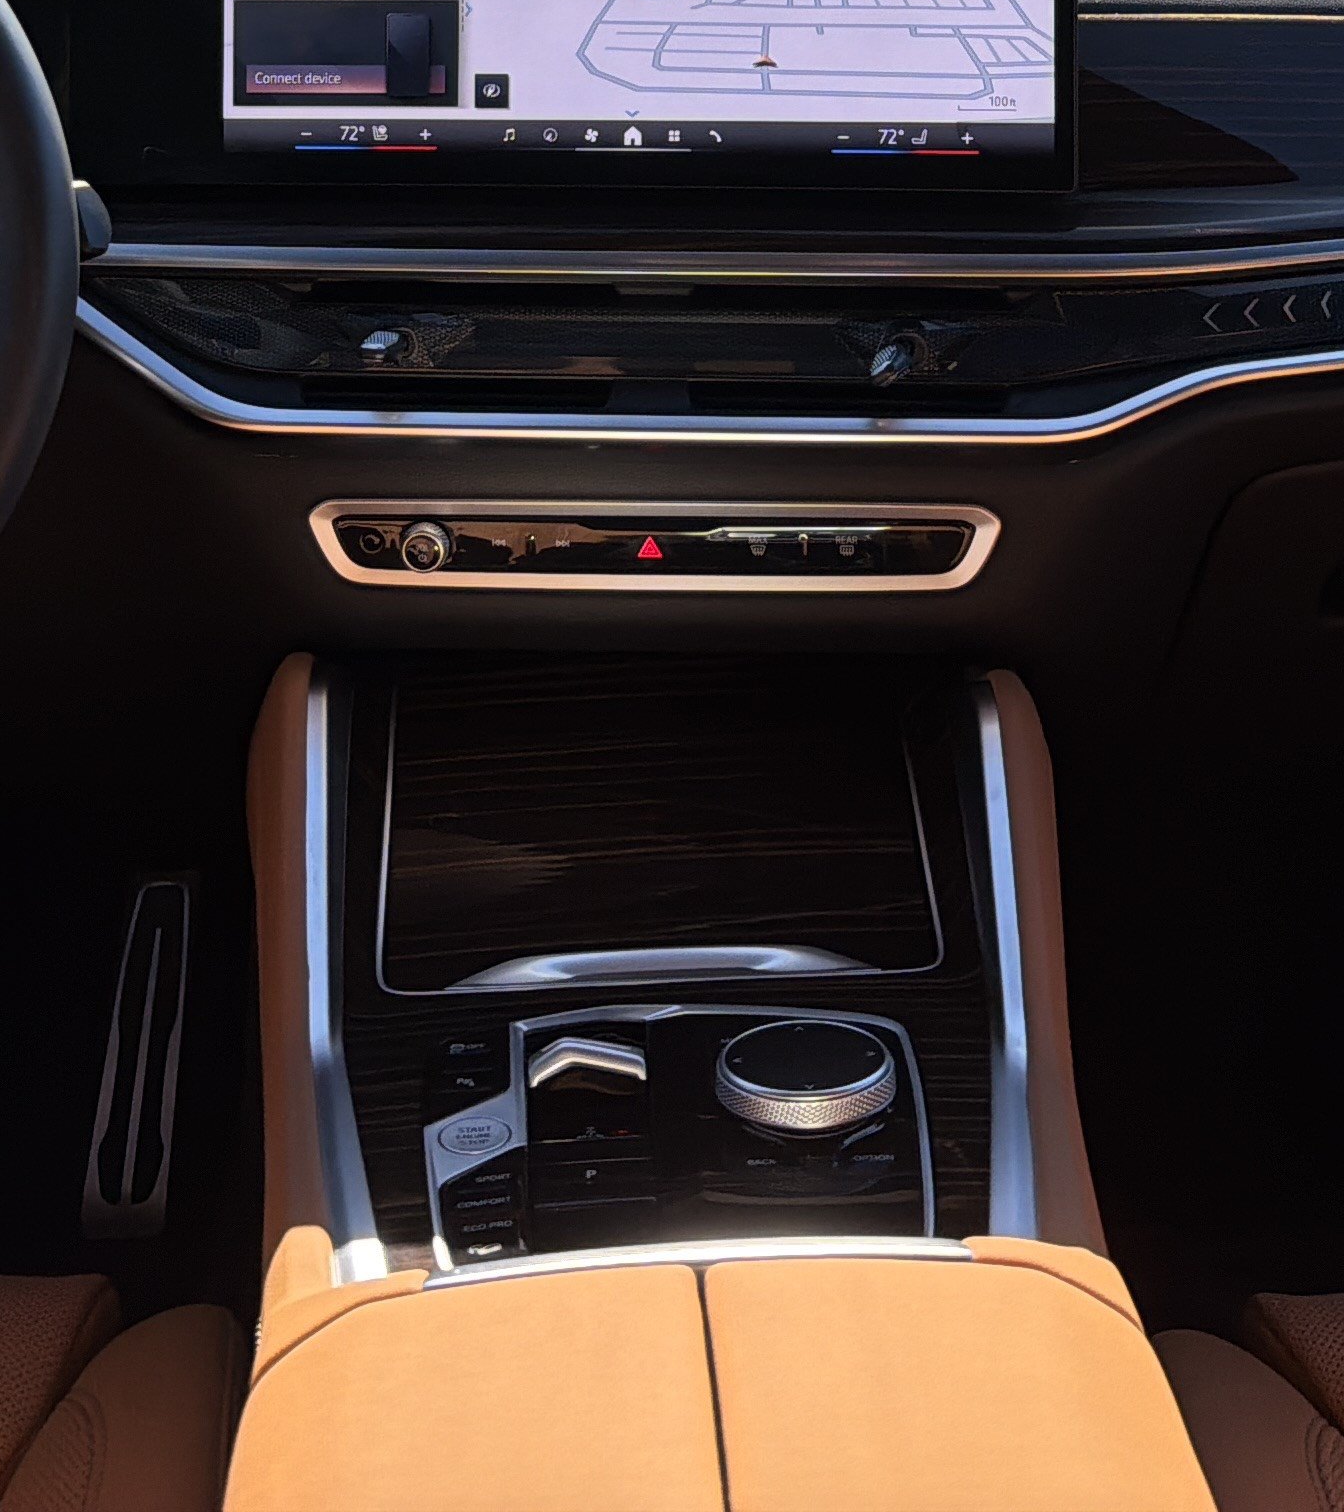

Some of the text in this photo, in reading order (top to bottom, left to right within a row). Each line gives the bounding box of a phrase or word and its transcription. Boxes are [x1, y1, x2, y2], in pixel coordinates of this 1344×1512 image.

[254, 71, 342, 85] Connect device
[988, 95, 1009, 107] 100
[835, 535, 858, 545] REAR
[475, 1172, 512, 1184] SPORT
[585, 1169, 597, 1179] P
[456, 1196, 512, 1209] COMFORT
[463, 1220, 514, 1233] ECO PRO
